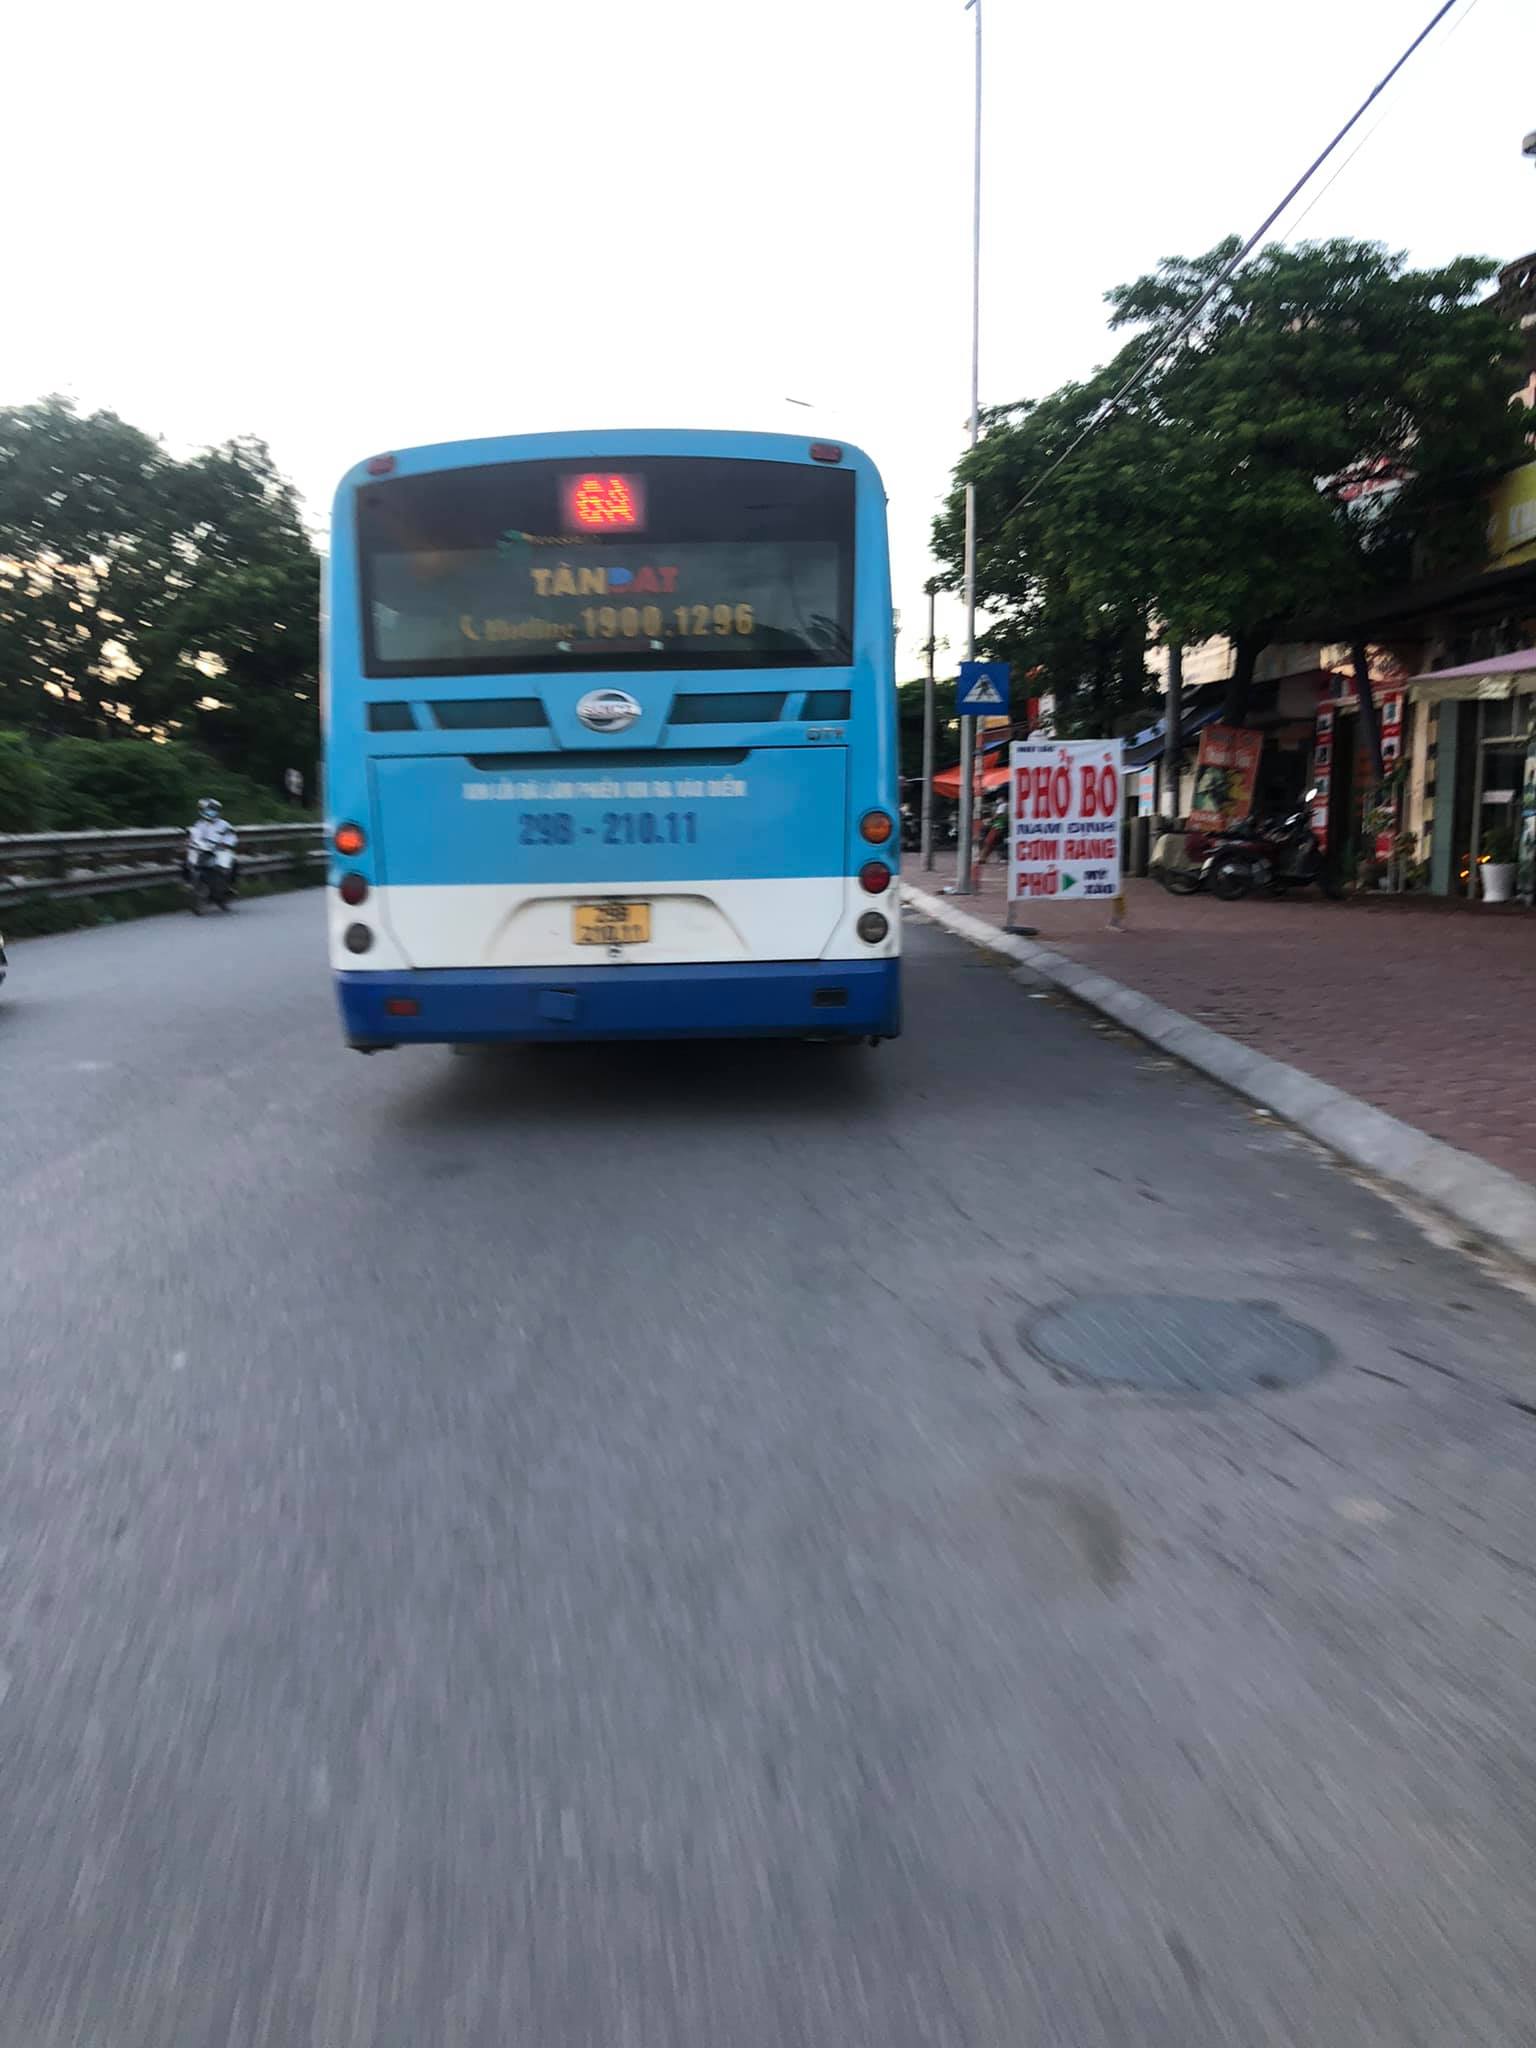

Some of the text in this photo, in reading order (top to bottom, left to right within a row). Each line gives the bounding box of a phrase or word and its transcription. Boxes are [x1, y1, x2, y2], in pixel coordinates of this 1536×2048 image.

[1015, 747, 1073, 819] PHỞ
[519, 812, 572, 846] 29B
[602, 811, 698, 845] 210.11
[1016, 822, 1063, 835] NAM
[1064, 838, 1117, 860] RANG
